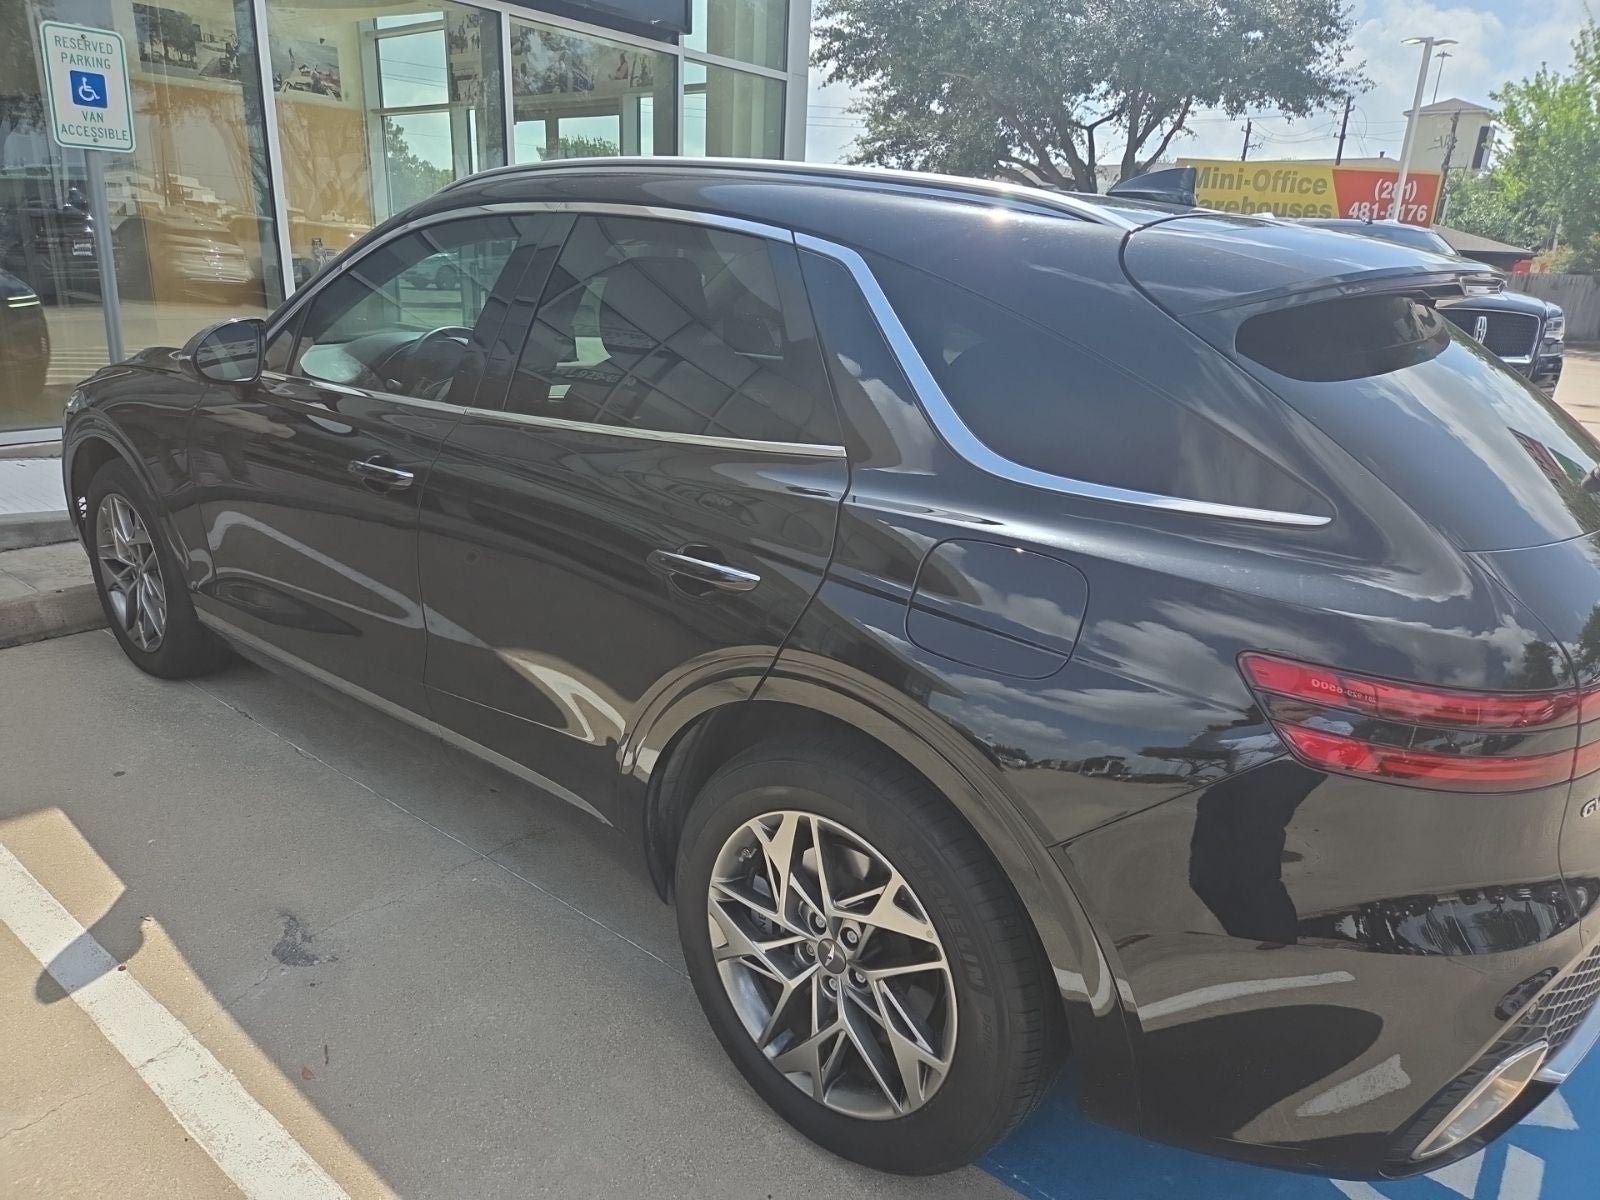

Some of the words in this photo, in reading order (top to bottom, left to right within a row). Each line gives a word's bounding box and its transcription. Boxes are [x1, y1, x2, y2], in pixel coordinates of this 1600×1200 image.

[54, 35, 113, 55] RESERVED
[60, 52, 111, 70] PARKING
[81, 110, 104, 123] VAN
[61, 123, 129, 141] ACCESSIBLE
[1196, 194, 1333, 219] arehouses
[900, 844, 986, 988] MICHELIN
